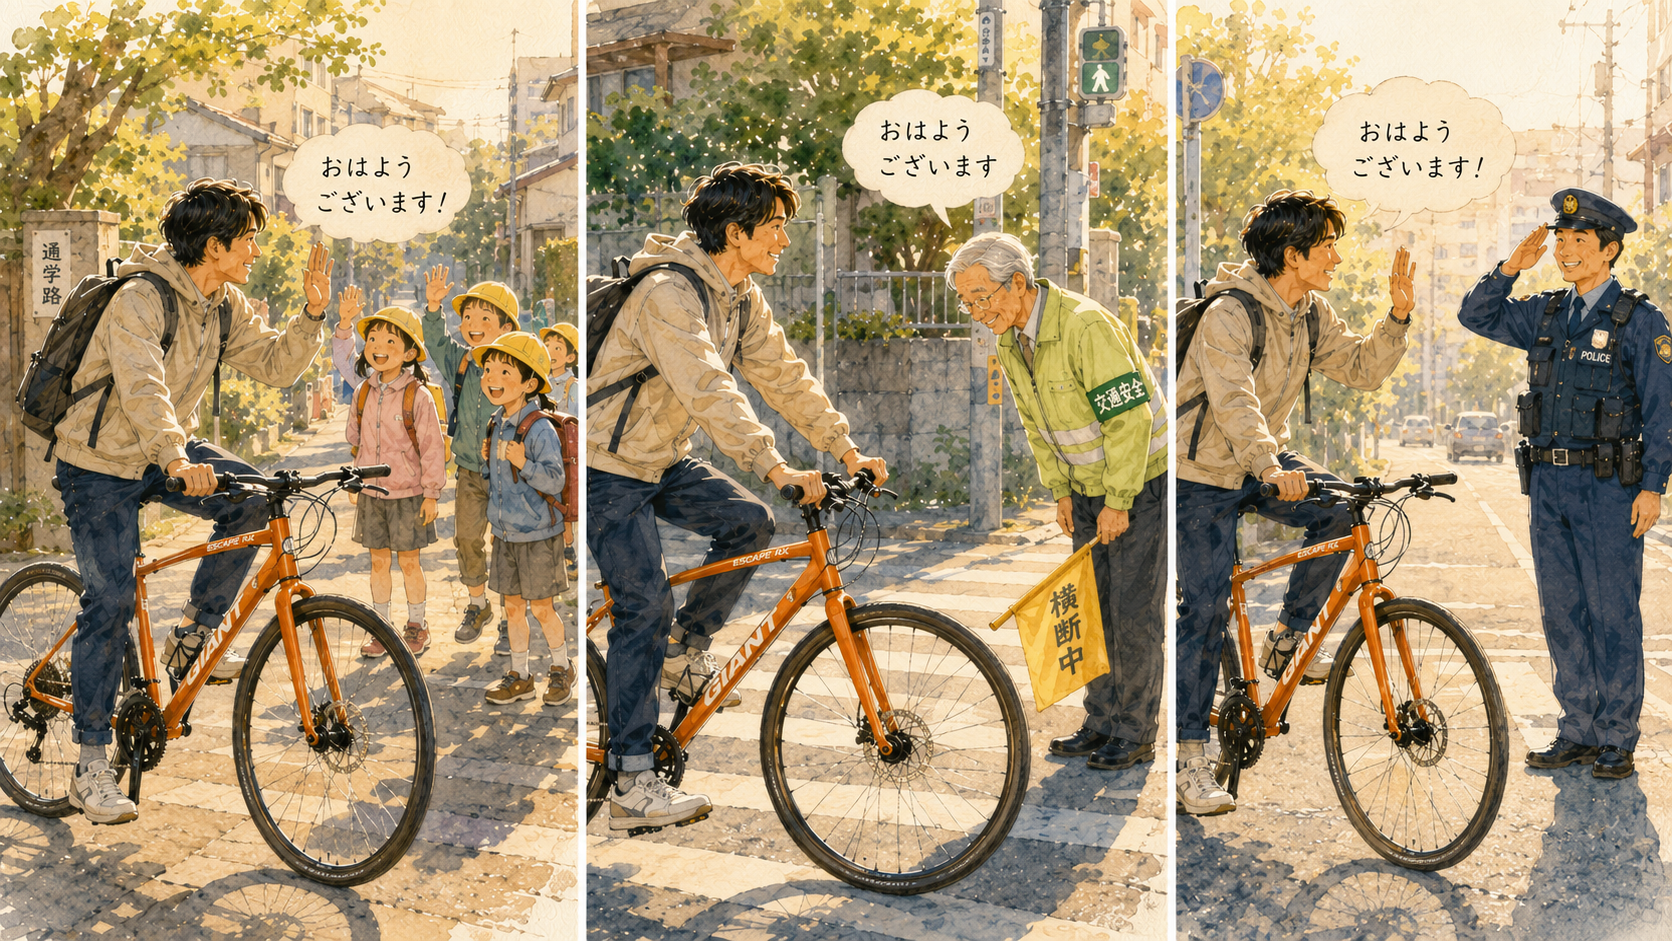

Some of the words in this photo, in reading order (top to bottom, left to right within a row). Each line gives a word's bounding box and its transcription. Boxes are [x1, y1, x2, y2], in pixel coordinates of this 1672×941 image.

[41, 241, 62, 305] 通学路
[1580, 349, 1612, 364] POLICE
[732, 550, 772, 567] ESCAPE
[185, 592, 245, 686] GIANT
[703, 606, 778, 707] GIANT
[1049, 582, 1084, 675] 横断中
[1281, 596, 1331, 686] GIANT
